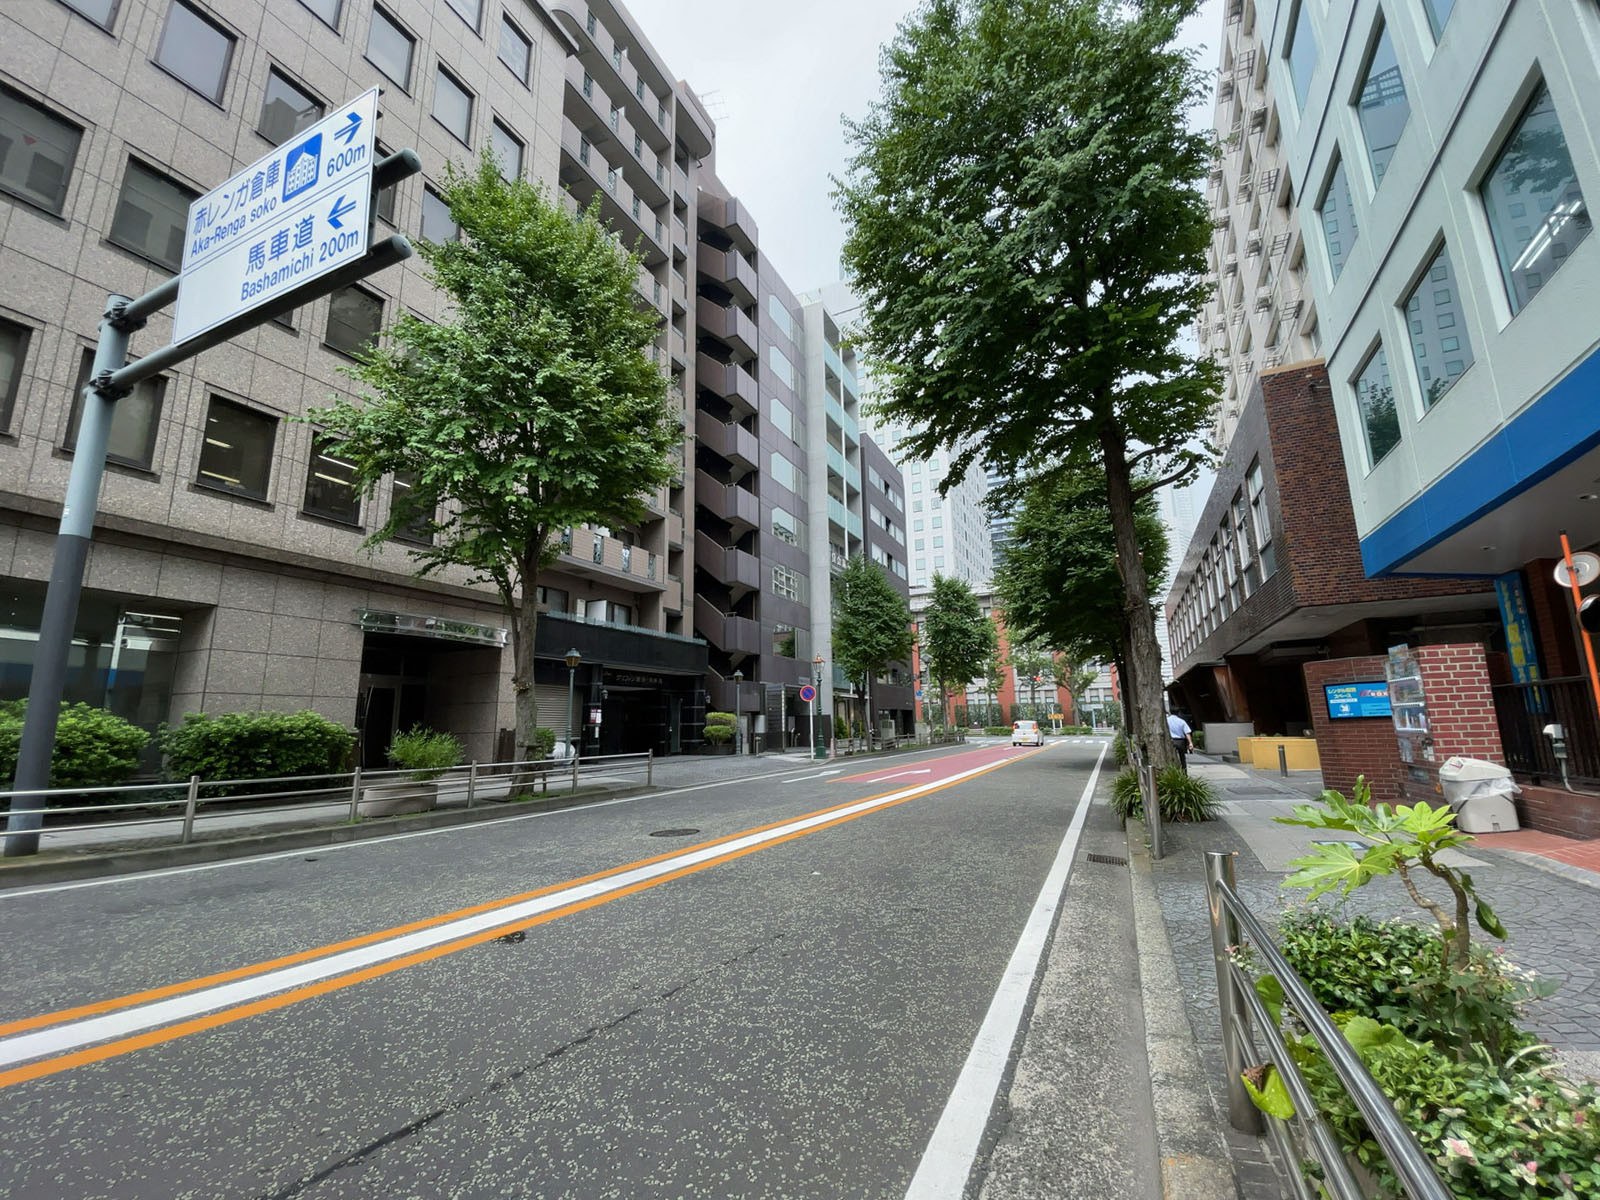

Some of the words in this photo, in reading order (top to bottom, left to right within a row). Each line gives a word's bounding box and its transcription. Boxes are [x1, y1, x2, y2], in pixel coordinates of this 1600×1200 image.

[327, 144, 366, 178] 600m
[190, 214, 247, 258] Aka-Renga
[250, 196, 277, 223] soko
[193, 159, 281, 236] 赤レンガ倉庫
[241, 248, 314, 301] Bashamichi
[319, 230, 359, 263] 200m
[245, 214, 315, 276] 馬車道
